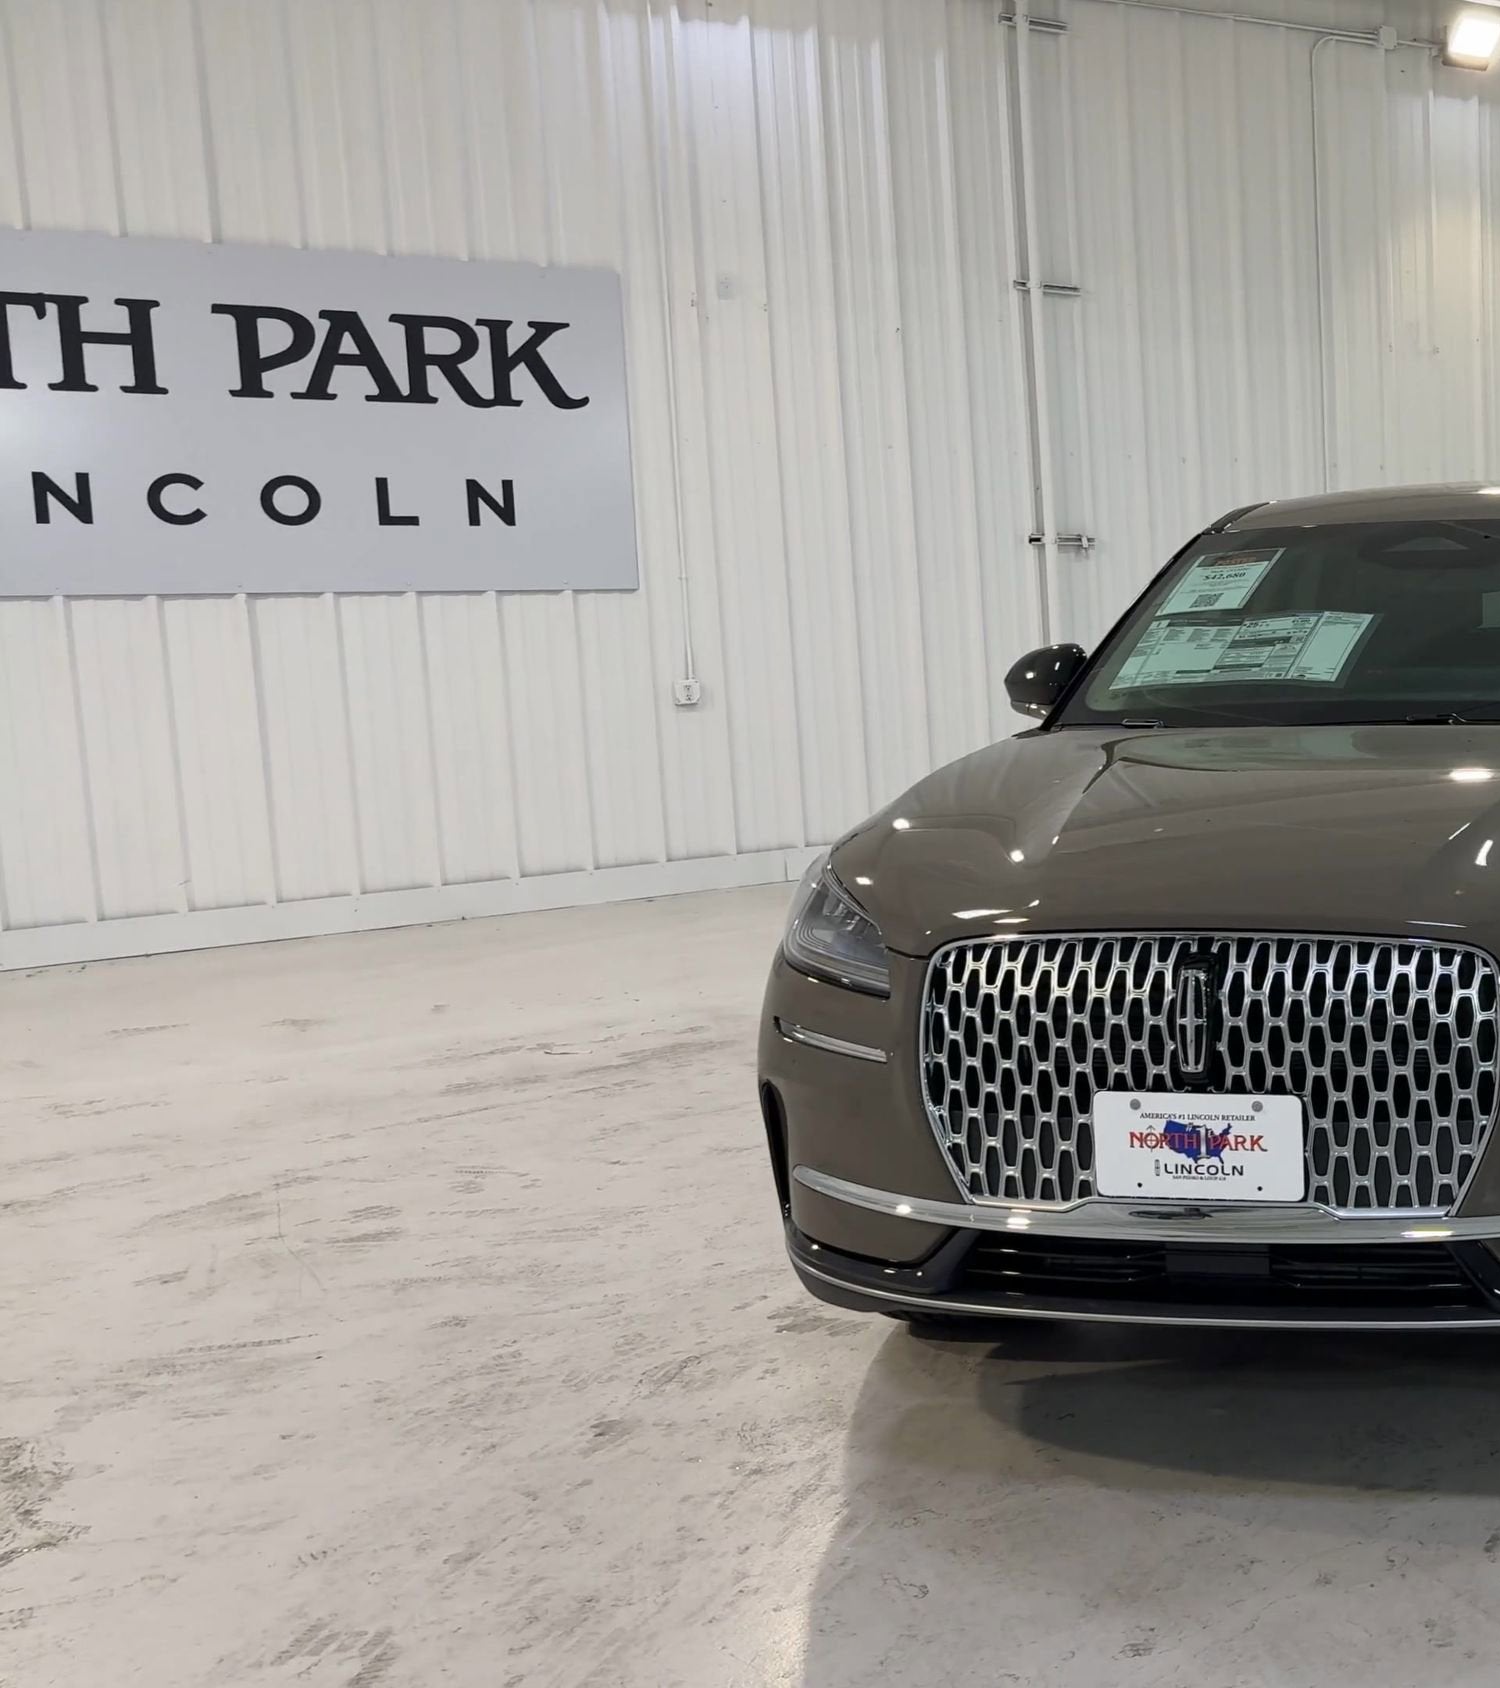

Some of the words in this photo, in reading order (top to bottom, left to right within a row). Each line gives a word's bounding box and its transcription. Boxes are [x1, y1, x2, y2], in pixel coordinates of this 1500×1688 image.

[211, 303, 590, 410] PARK
[31, 471, 517, 527] NCOLN
[1140, 1112, 1177, 1120] AMERICA'S
[1187, 1113, 1220, 1121] LINCOLN
[1129, 1131, 1198, 1150] NORTH
[1209, 1134, 1268, 1152] PARK
[1164, 1163, 1244, 1176] LINCOLN
